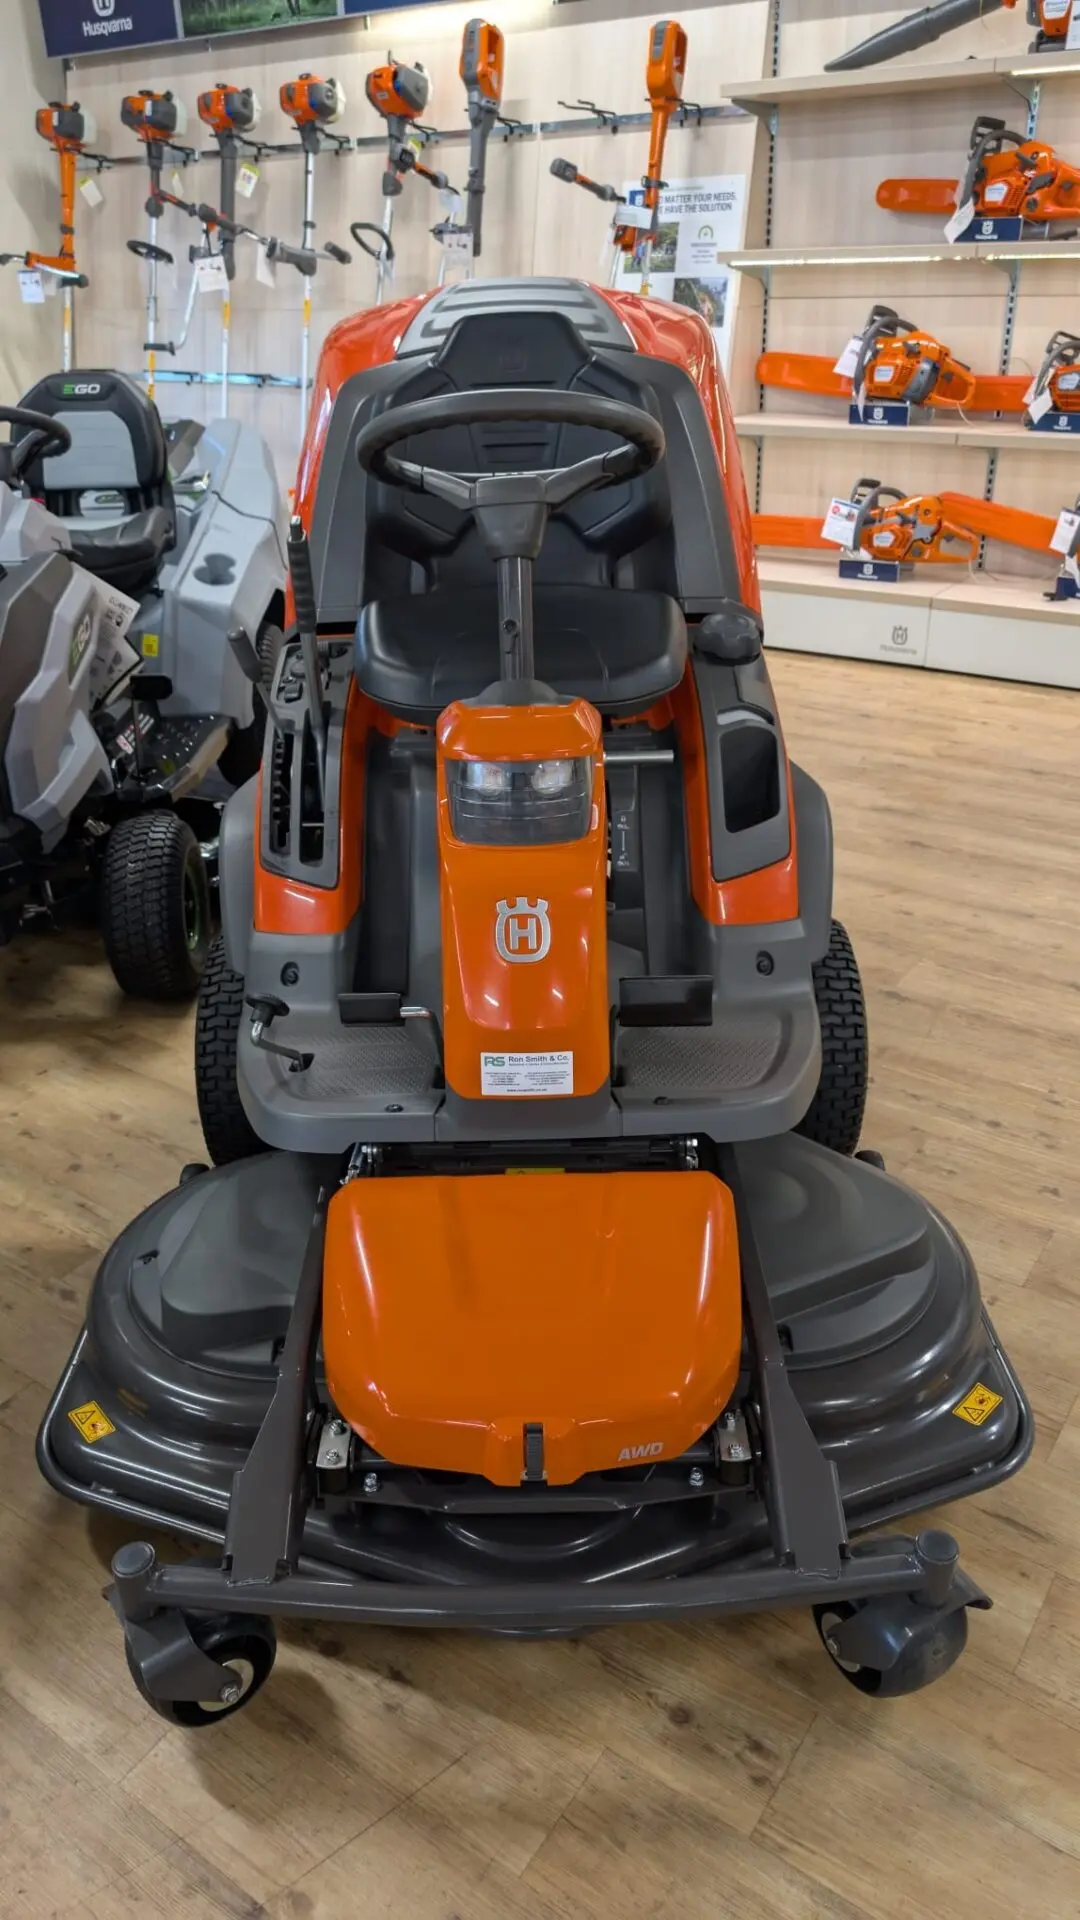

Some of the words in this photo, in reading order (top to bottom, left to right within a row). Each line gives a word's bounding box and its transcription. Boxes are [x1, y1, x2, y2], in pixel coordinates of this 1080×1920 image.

[82, 17, 133, 36] Husqvarna
[665, 194, 692, 204] MATTER
[693, 192, 712, 203] YOUR
[665, 204, 683, 214] HAVE
[685, 203, 698, 213] THE
[698, 202, 732, 213] SOLUTION
[63, 383, 101, 395] EGO
[484, 1055, 506, 1067] RS
[508, 1055, 524, 1063] Ron
[525, 1055, 548, 1063] Smith
[557, 1054, 570, 1062] Co.
[618, 1441, 664, 1462] AWD
